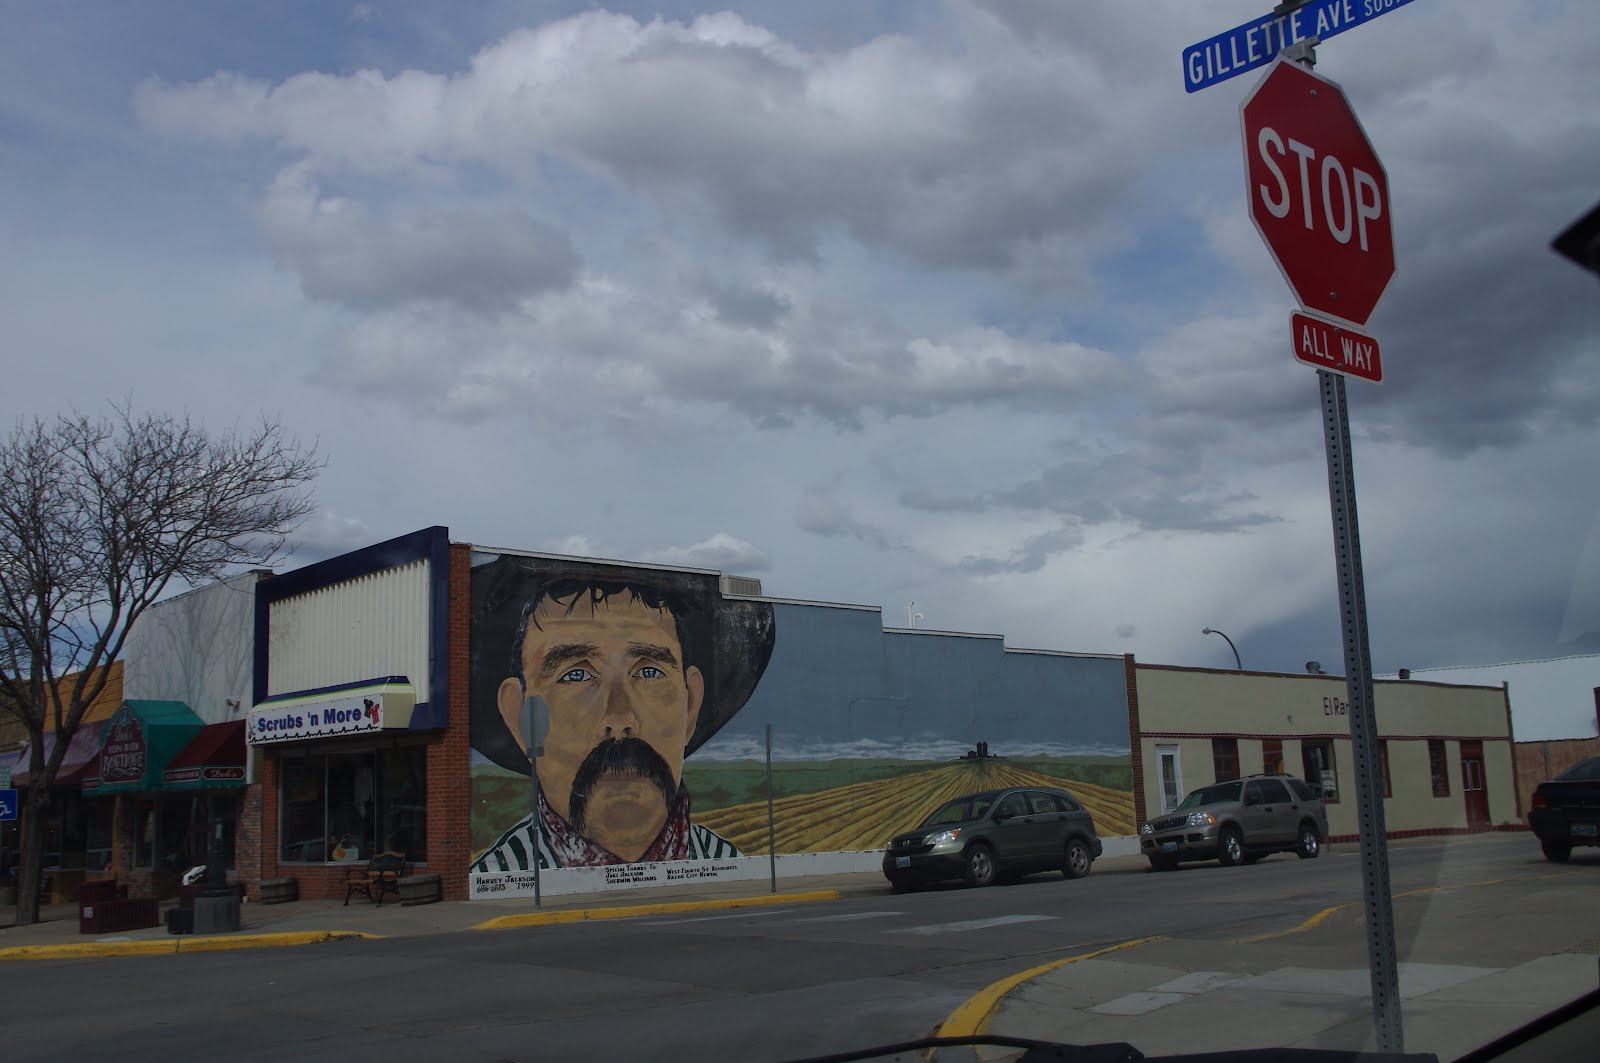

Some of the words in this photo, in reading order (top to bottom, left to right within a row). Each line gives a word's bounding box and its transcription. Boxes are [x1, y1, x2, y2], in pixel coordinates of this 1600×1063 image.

[1189, 8, 1305, 84] GILLETTE
[1316, 0, 1356, 35] AVE
[1364, 0, 1400, 17] SO
[1258, 126, 1382, 252] STOP
[1302, 324, 1335, 361] ALL
[1340, 338, 1373, 372] WAY
[257, 714, 304, 733] Scrubs
[307, 711, 319, 727] 'n
[323, 707, 362, 725] More
[1323, 696, 1333, 716] El
